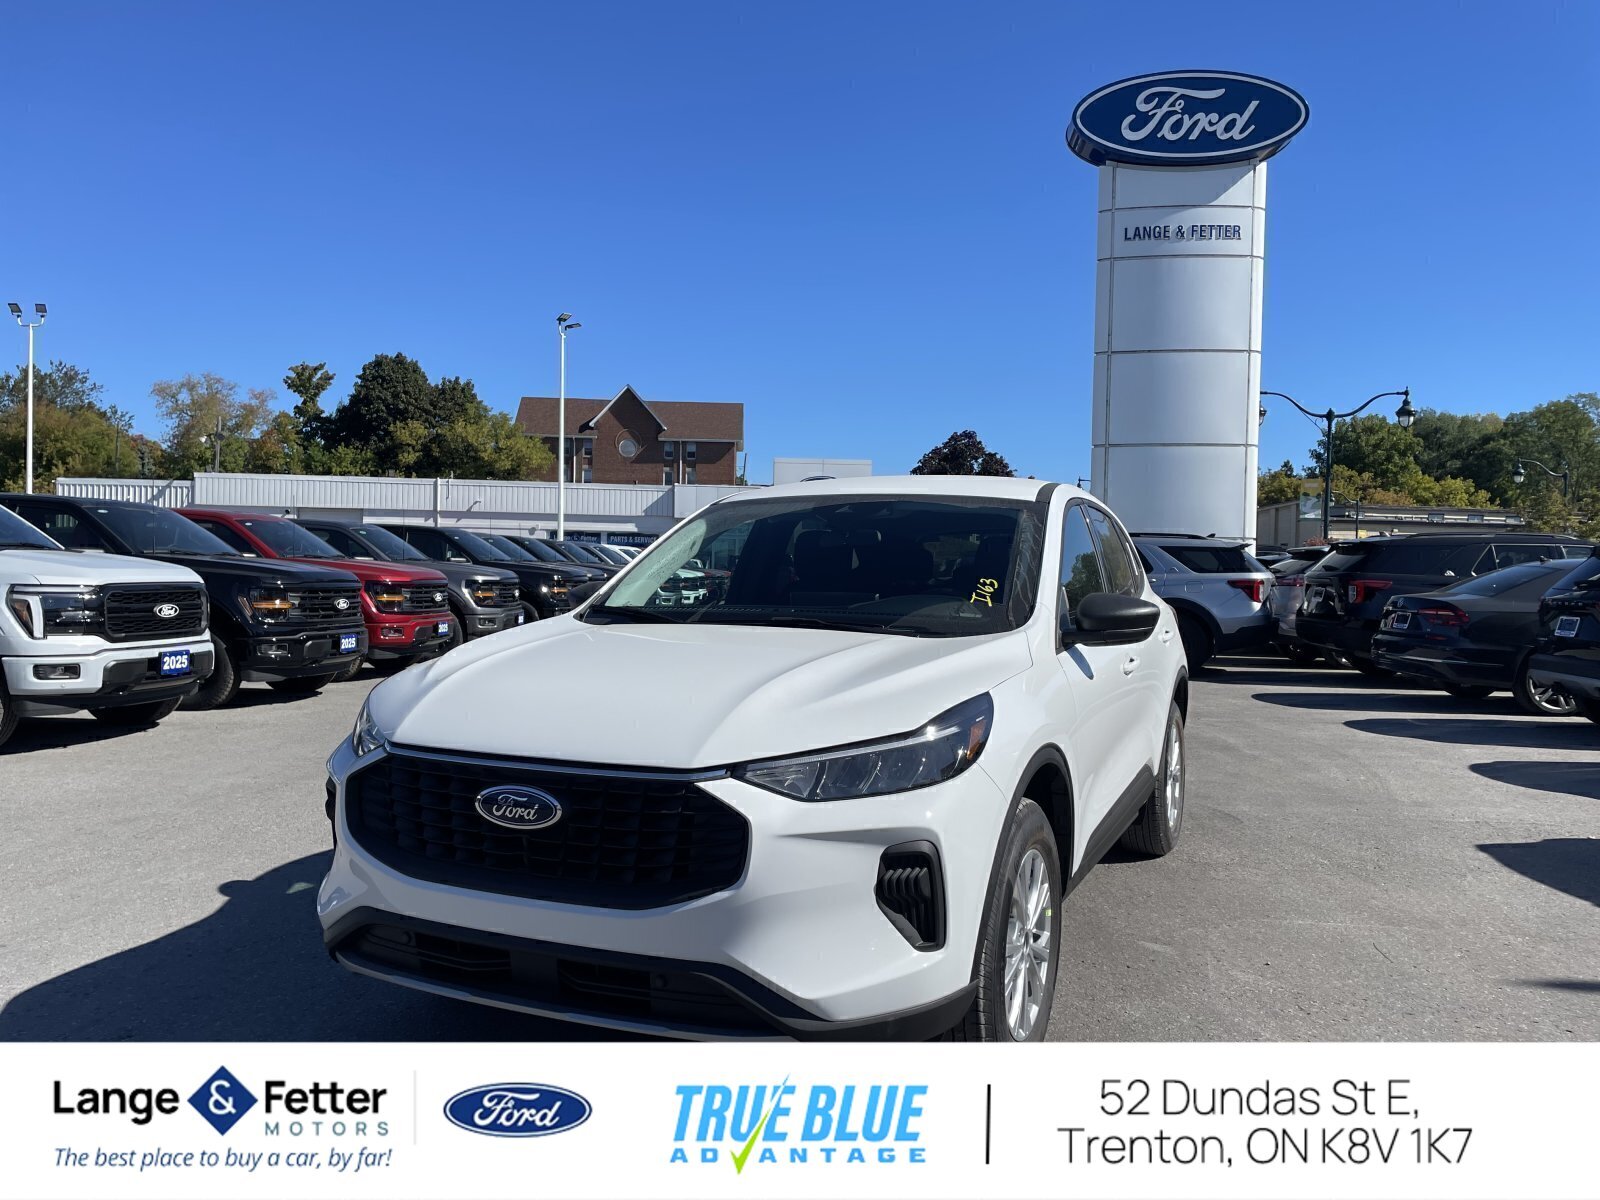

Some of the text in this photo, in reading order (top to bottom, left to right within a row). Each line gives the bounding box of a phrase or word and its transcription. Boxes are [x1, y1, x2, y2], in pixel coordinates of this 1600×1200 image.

[1121, 87, 1260, 141] Ford
[1124, 224, 1242, 241] LANGE & FETTER
[610, 535, 628, 543] PARTS
[341, 637, 356, 648] 2025
[163, 655, 188, 670] 2025
[493, 794, 539, 820] Ford
